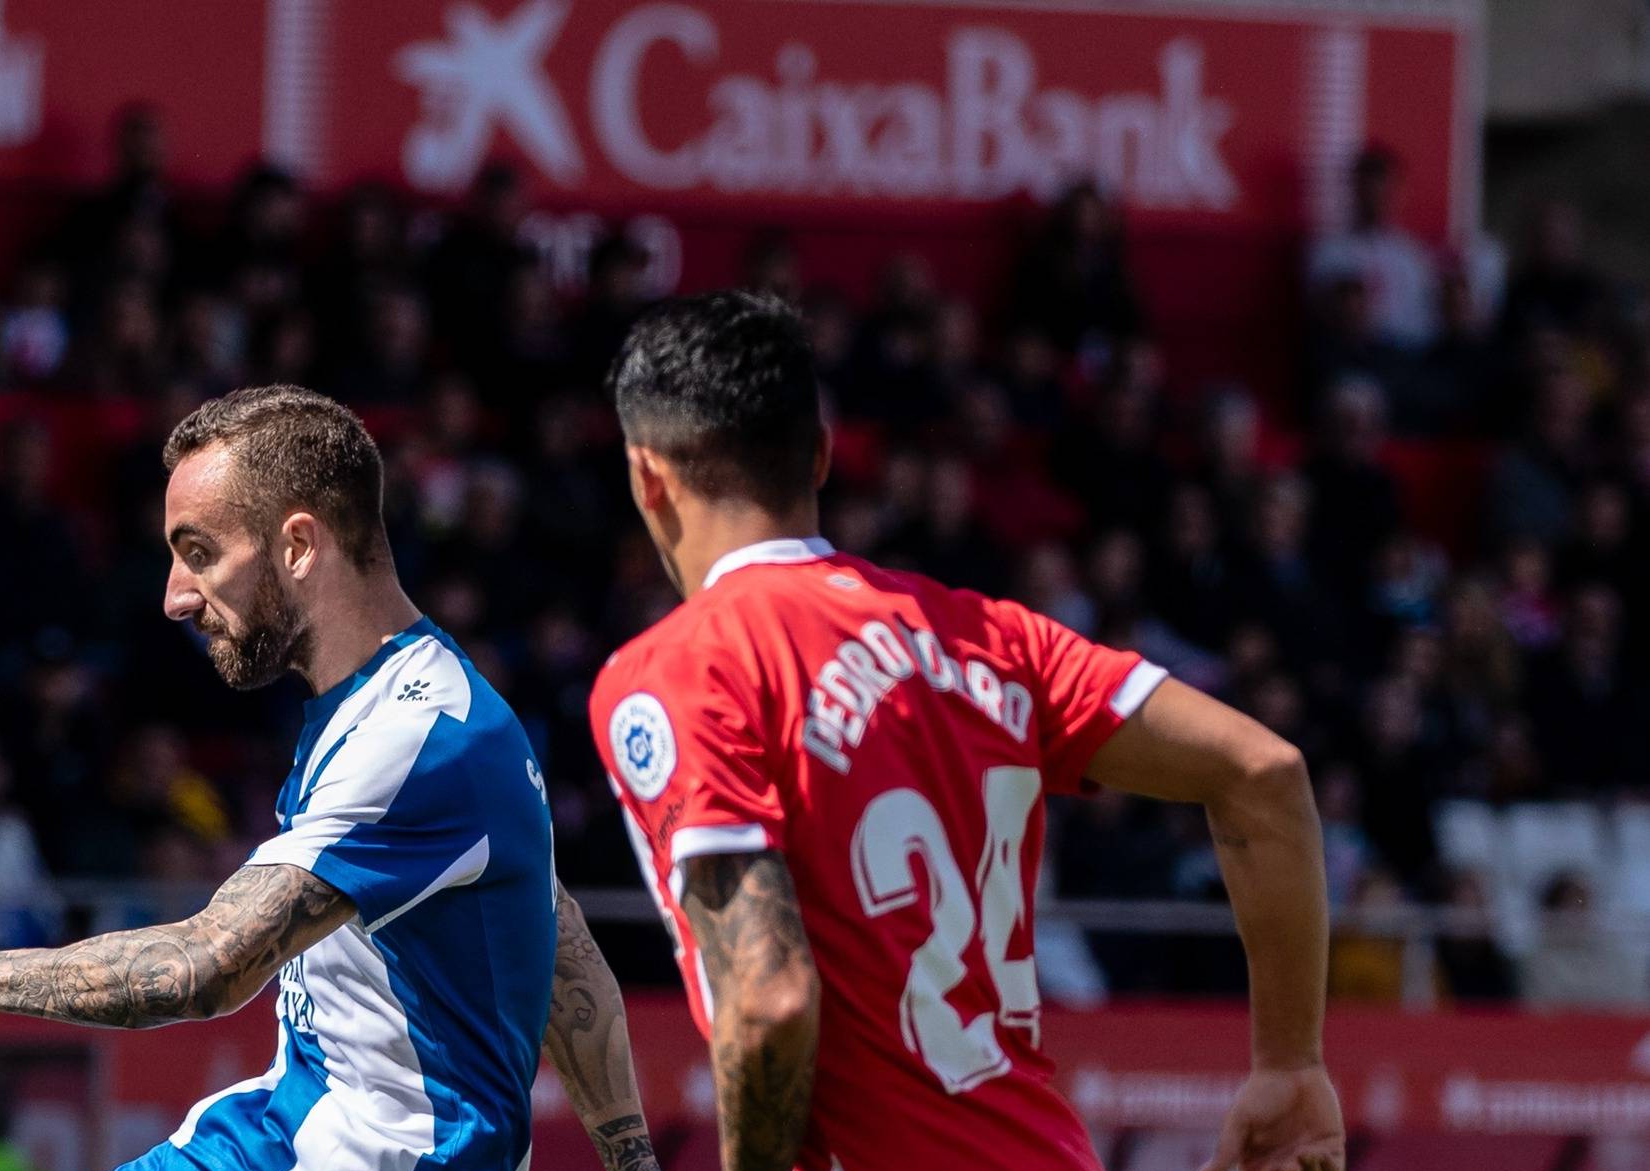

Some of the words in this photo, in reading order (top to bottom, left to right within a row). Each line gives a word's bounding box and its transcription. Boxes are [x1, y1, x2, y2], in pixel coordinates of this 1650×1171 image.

[591, 5, 1240, 211] CaixaBank
[803, 620, 915, 776] PEDRO
[850, 765, 1042, 1094] 24
